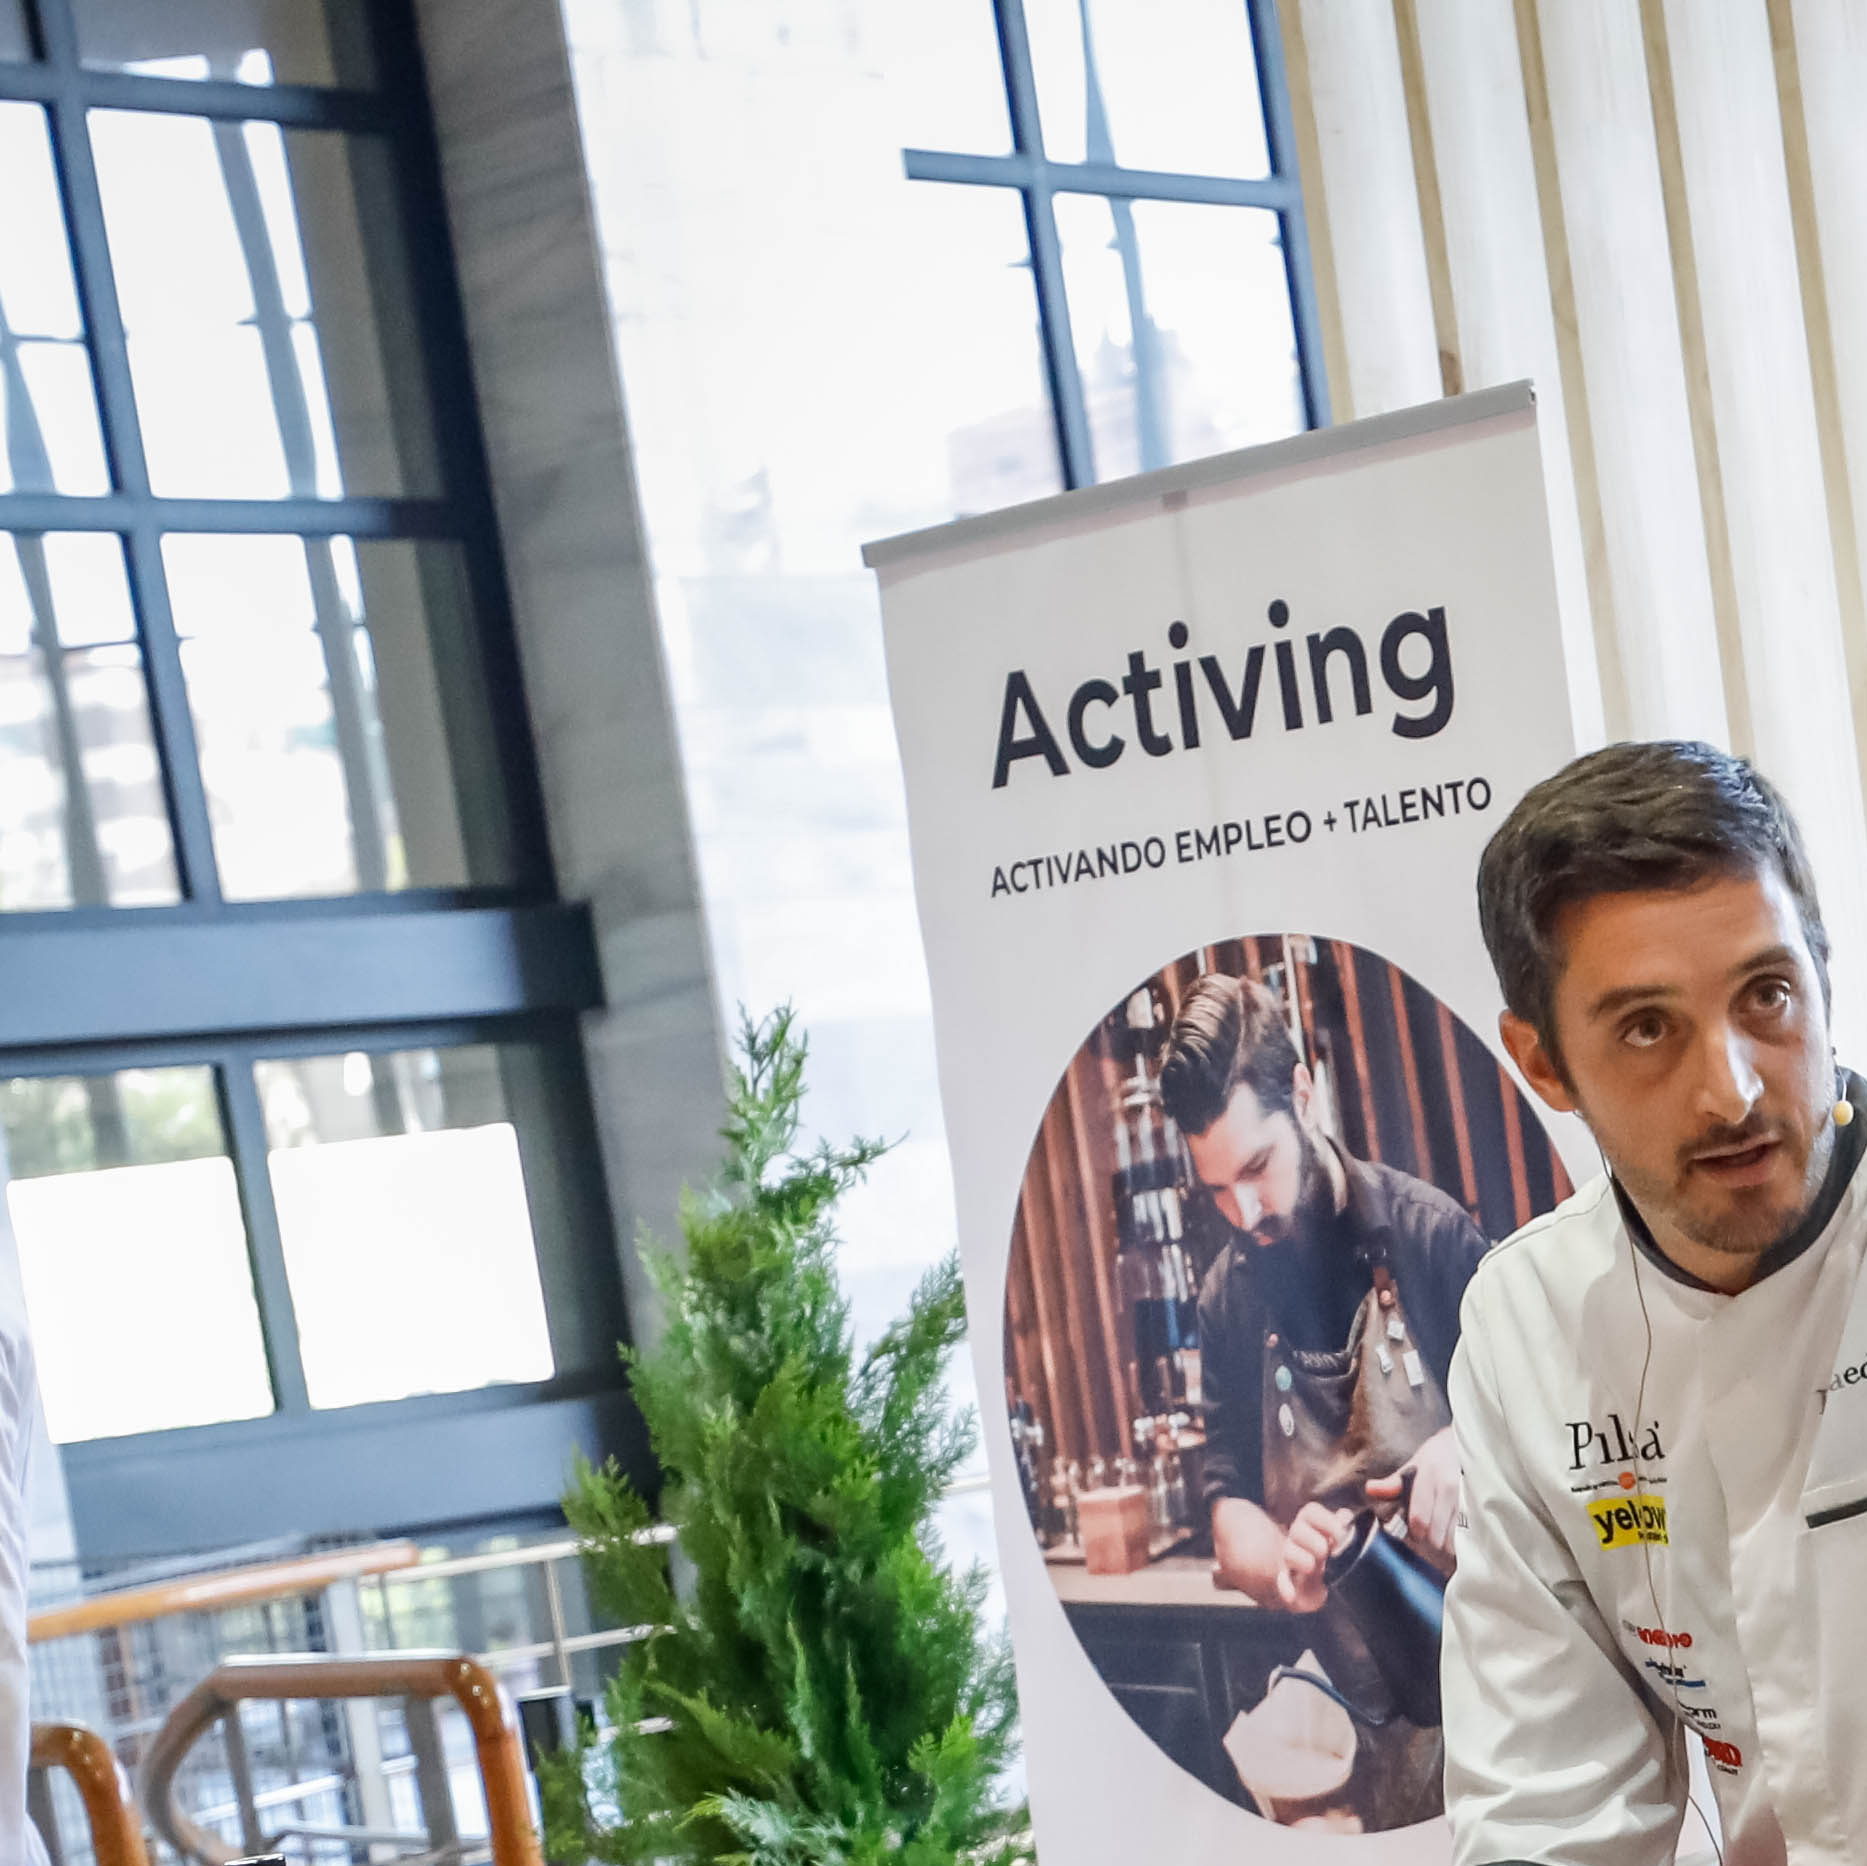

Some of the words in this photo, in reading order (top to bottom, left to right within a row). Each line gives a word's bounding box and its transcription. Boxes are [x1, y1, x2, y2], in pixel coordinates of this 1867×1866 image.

[991, 598, 1456, 790] Activing
[990, 835, 1166, 898] ACTIVANDO
[1175, 810, 1313, 865] EMPLEO
[1343, 777, 1493, 834] TALENTO
